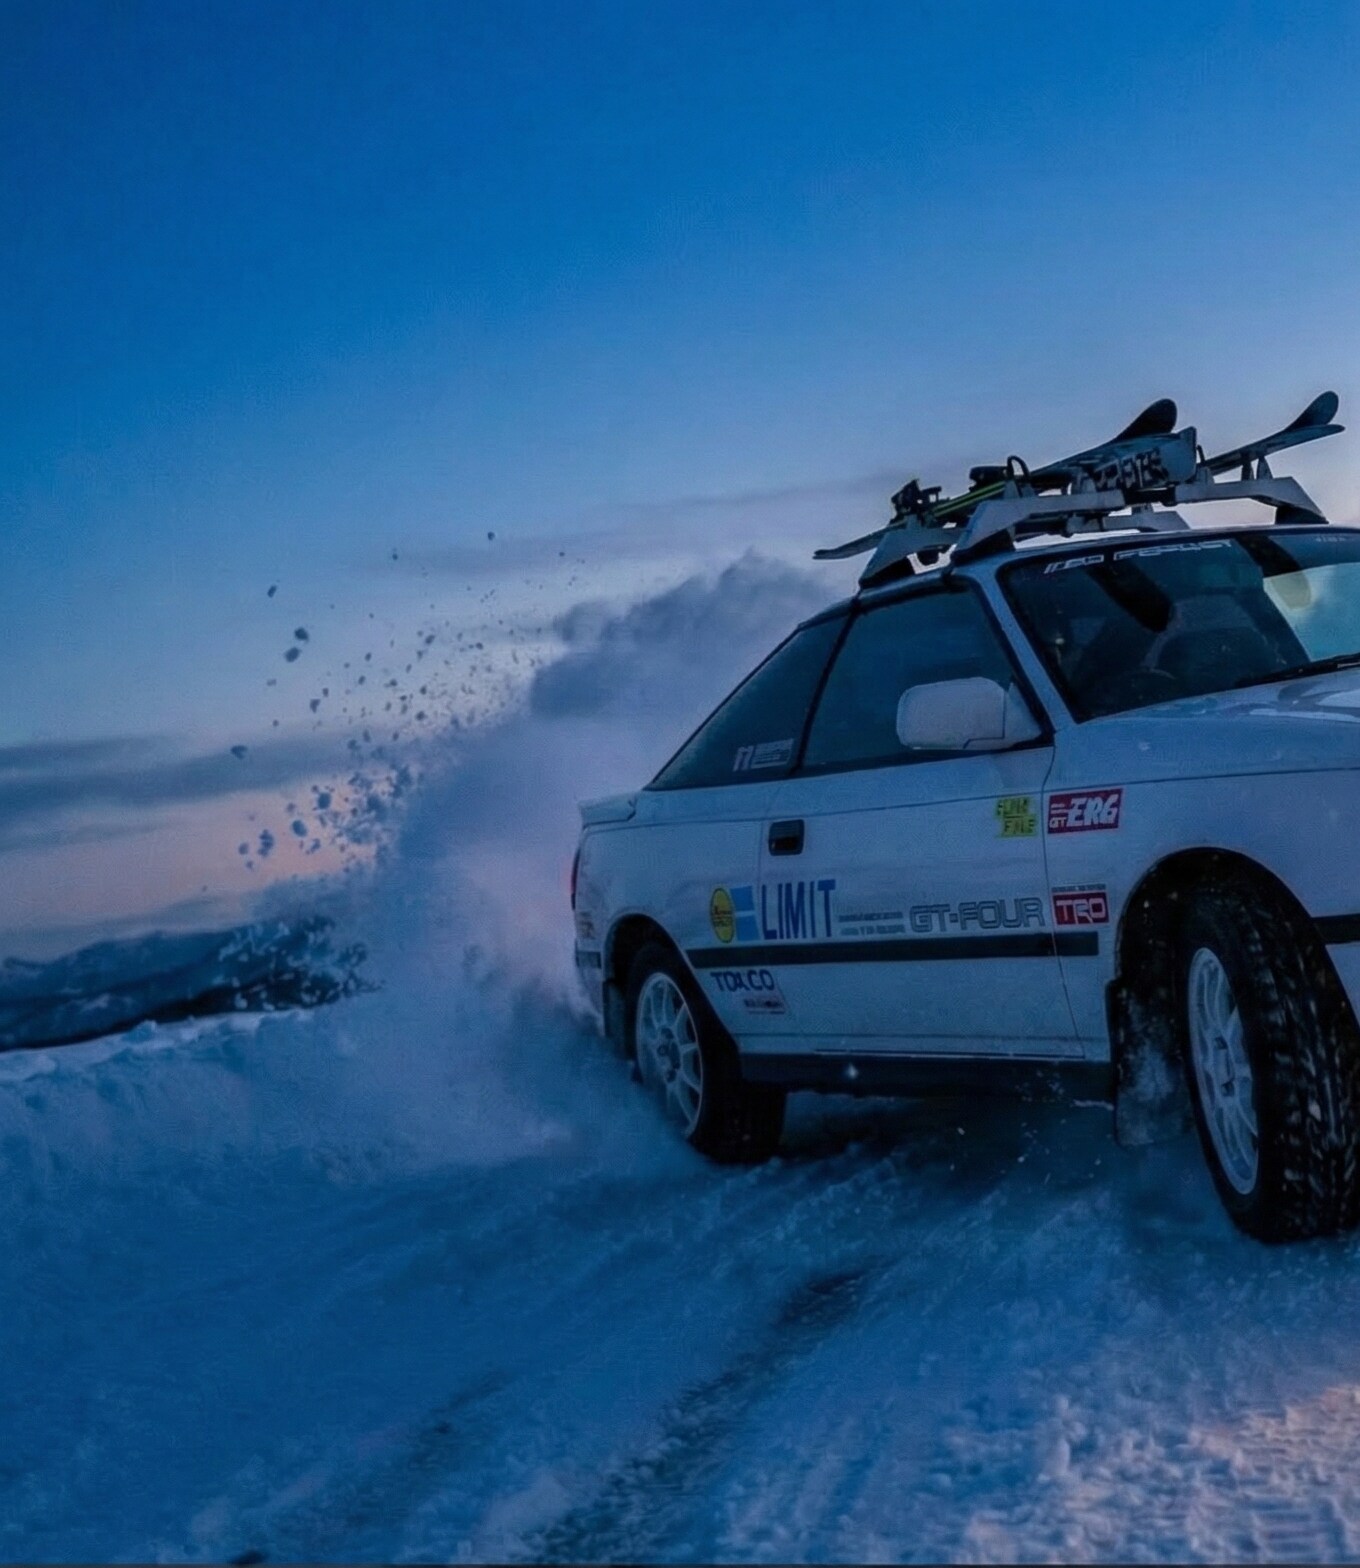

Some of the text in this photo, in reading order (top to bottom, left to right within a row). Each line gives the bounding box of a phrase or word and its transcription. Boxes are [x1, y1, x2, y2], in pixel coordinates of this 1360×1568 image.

[1066, 794, 1119, 827] ERG
[761, 879, 837, 940] LIMIT
[909, 897, 1046, 933] GT-FOUR
